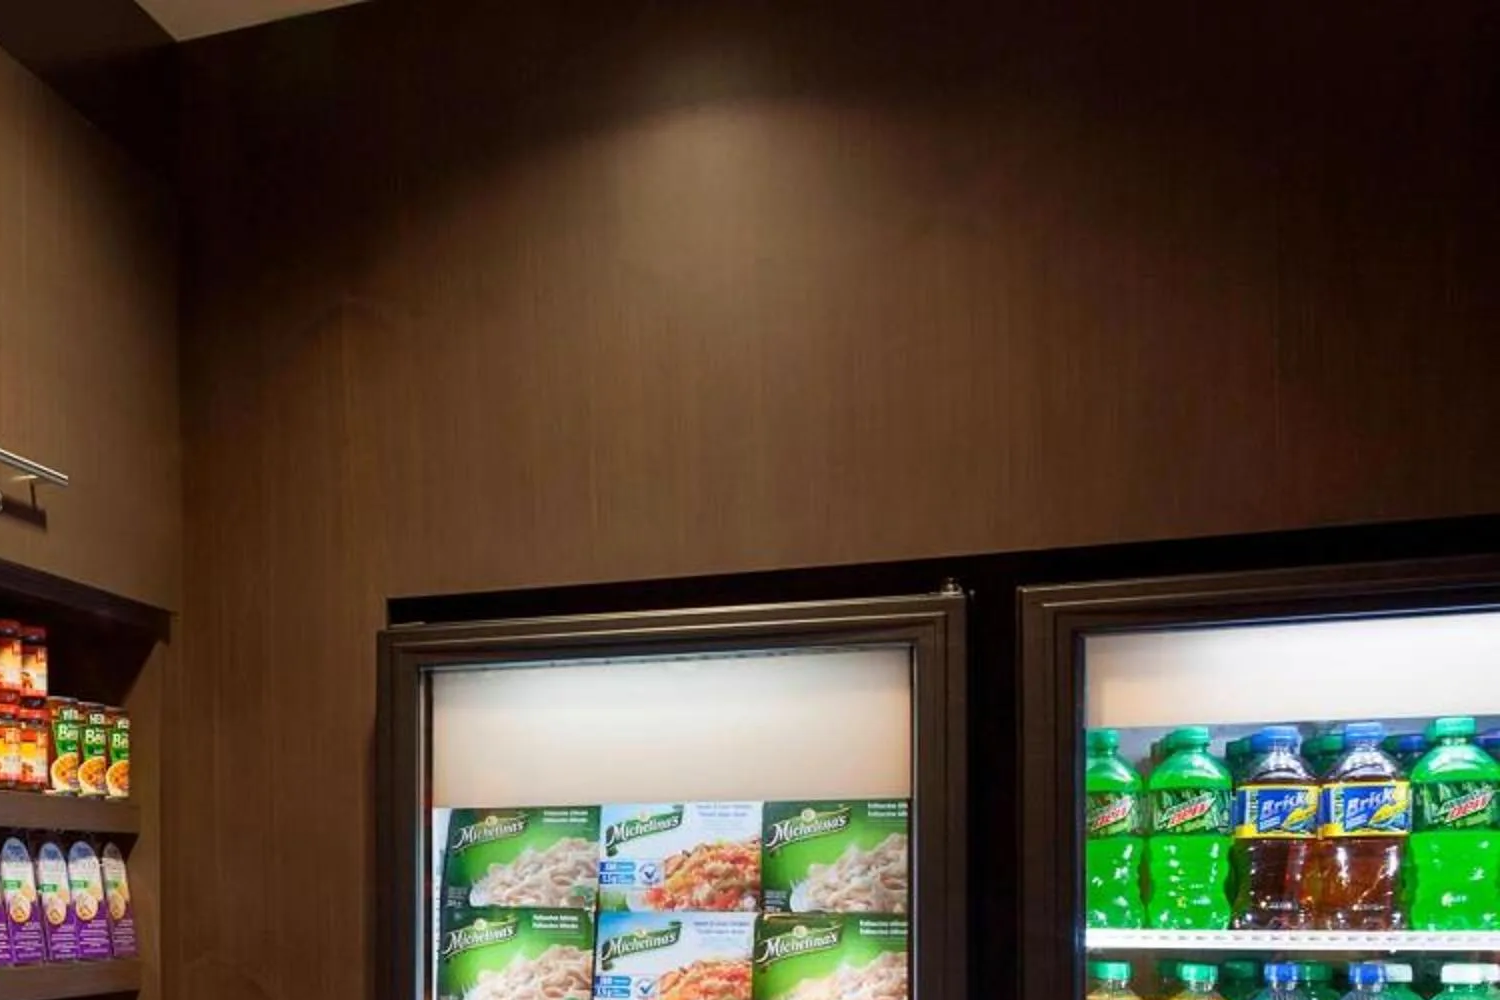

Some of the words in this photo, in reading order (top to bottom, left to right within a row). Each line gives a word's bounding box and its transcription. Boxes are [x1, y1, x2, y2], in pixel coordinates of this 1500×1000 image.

[1347, 787, 1395, 814] Brisk
[452, 820, 525, 849] Michelina's
[605, 815, 679, 847] Michelina's
[765, 815, 848, 848] Michelina's
[442, 925, 514, 955] Michelina's
[602, 932, 678, 961] Michelina's
[756, 932, 838, 964] Michelina's
